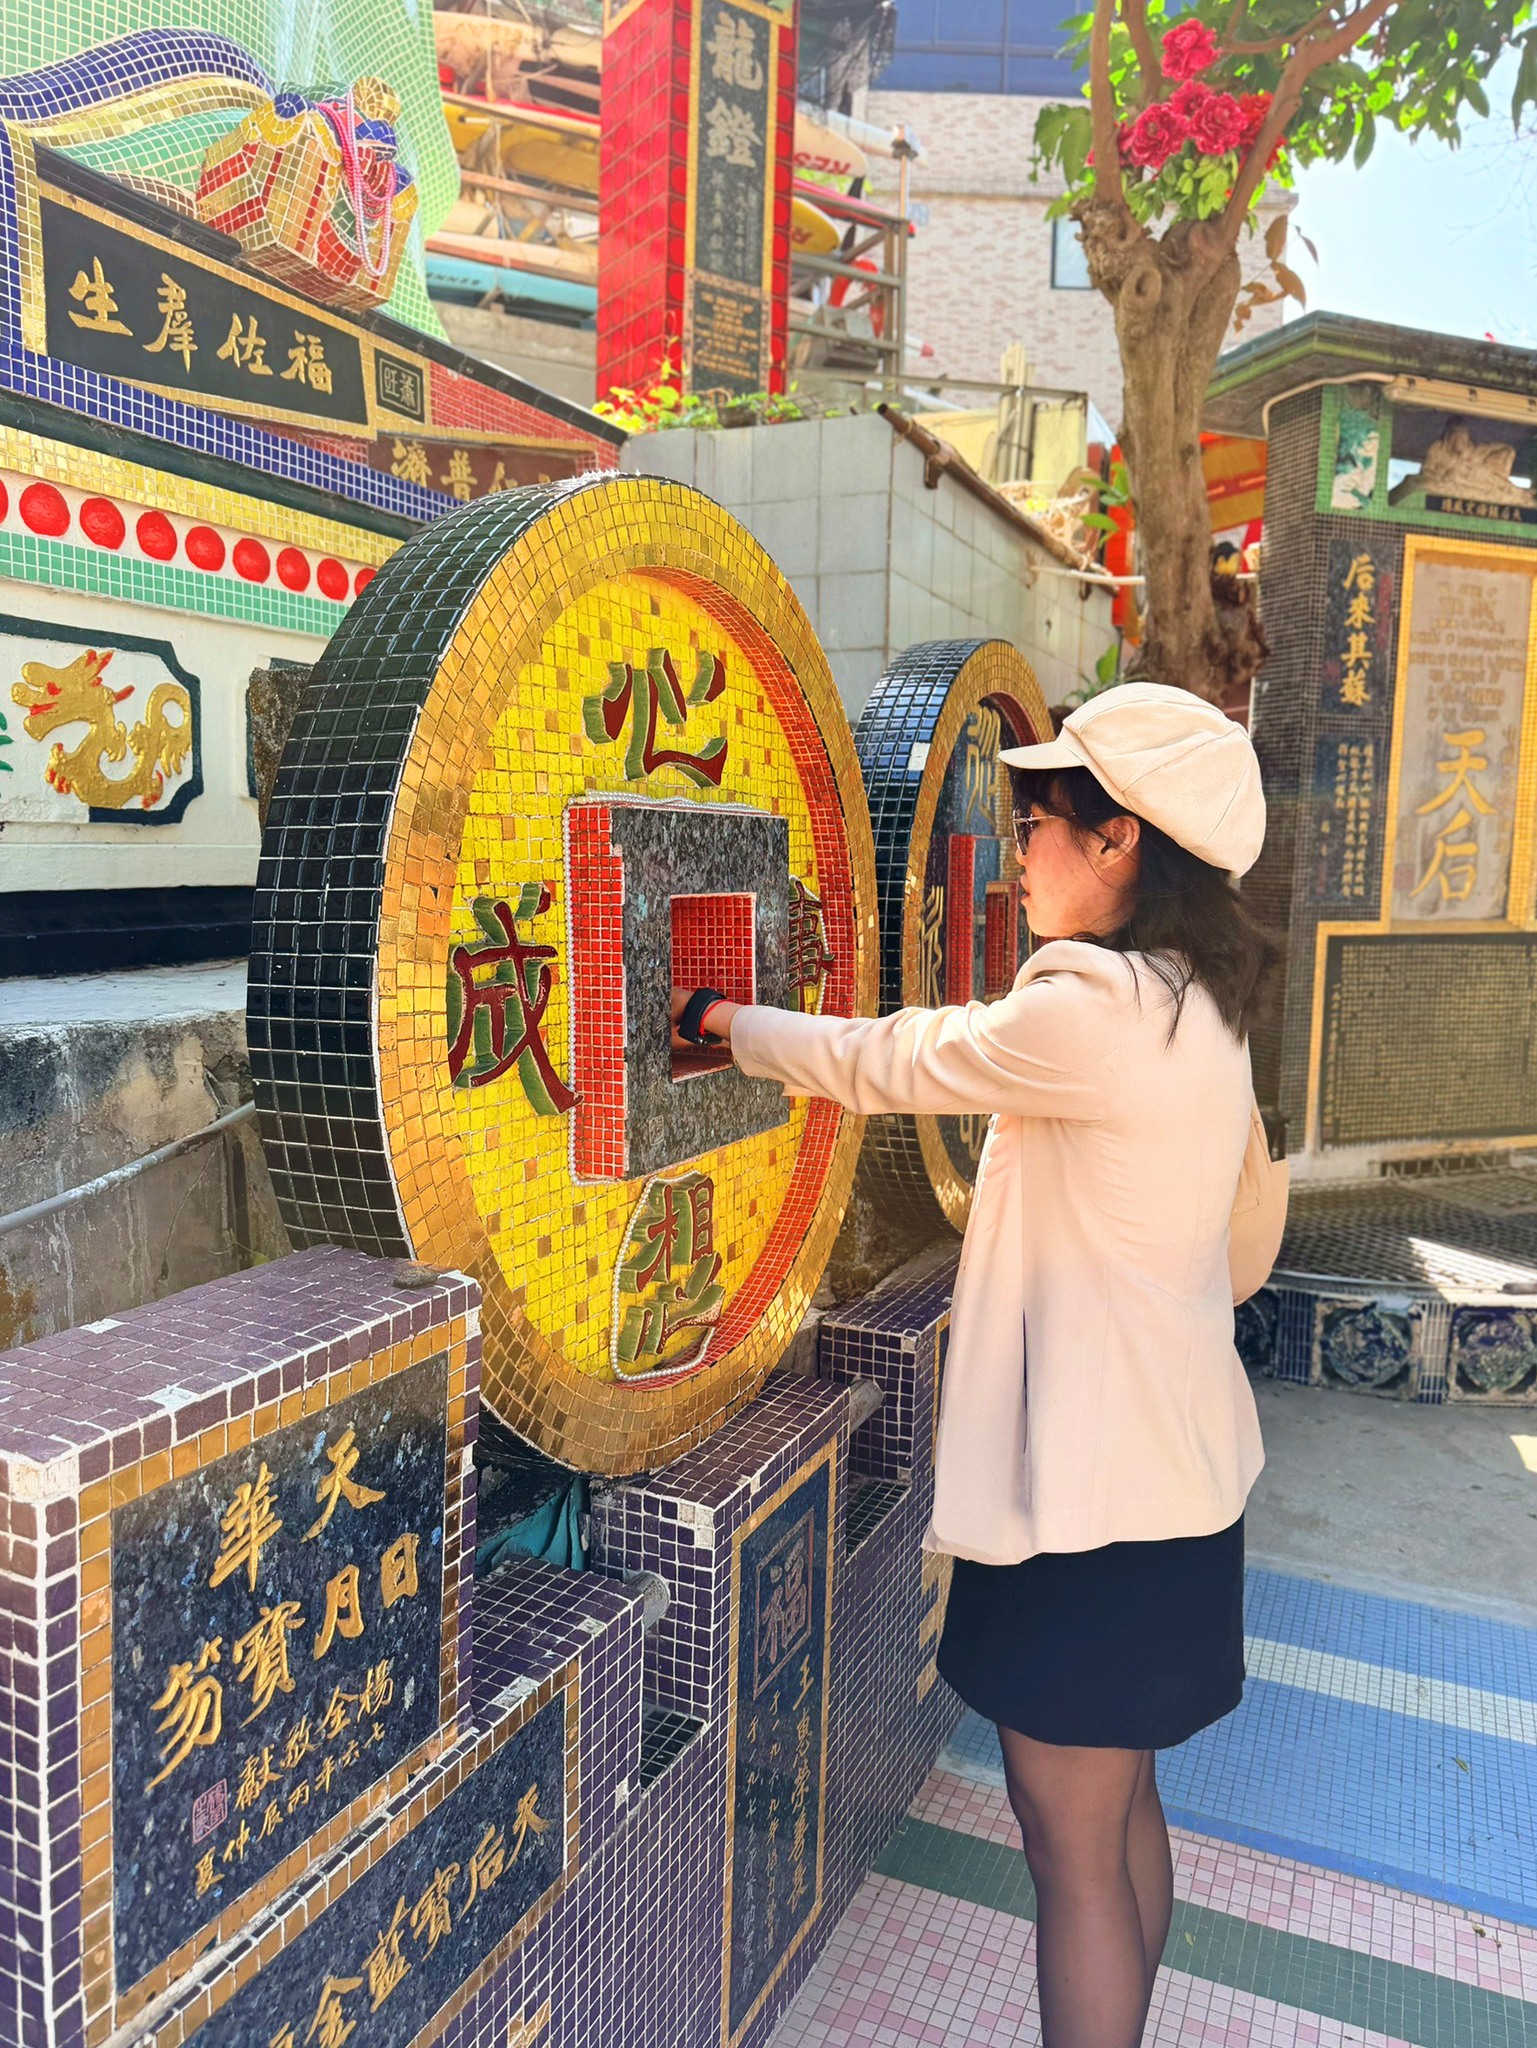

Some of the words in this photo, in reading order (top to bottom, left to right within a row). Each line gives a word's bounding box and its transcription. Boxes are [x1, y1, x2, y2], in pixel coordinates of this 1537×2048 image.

[583, 647, 728, 787] 心
[447, 883, 583, 1116] 成
[619, 1172, 726, 1362] 想
